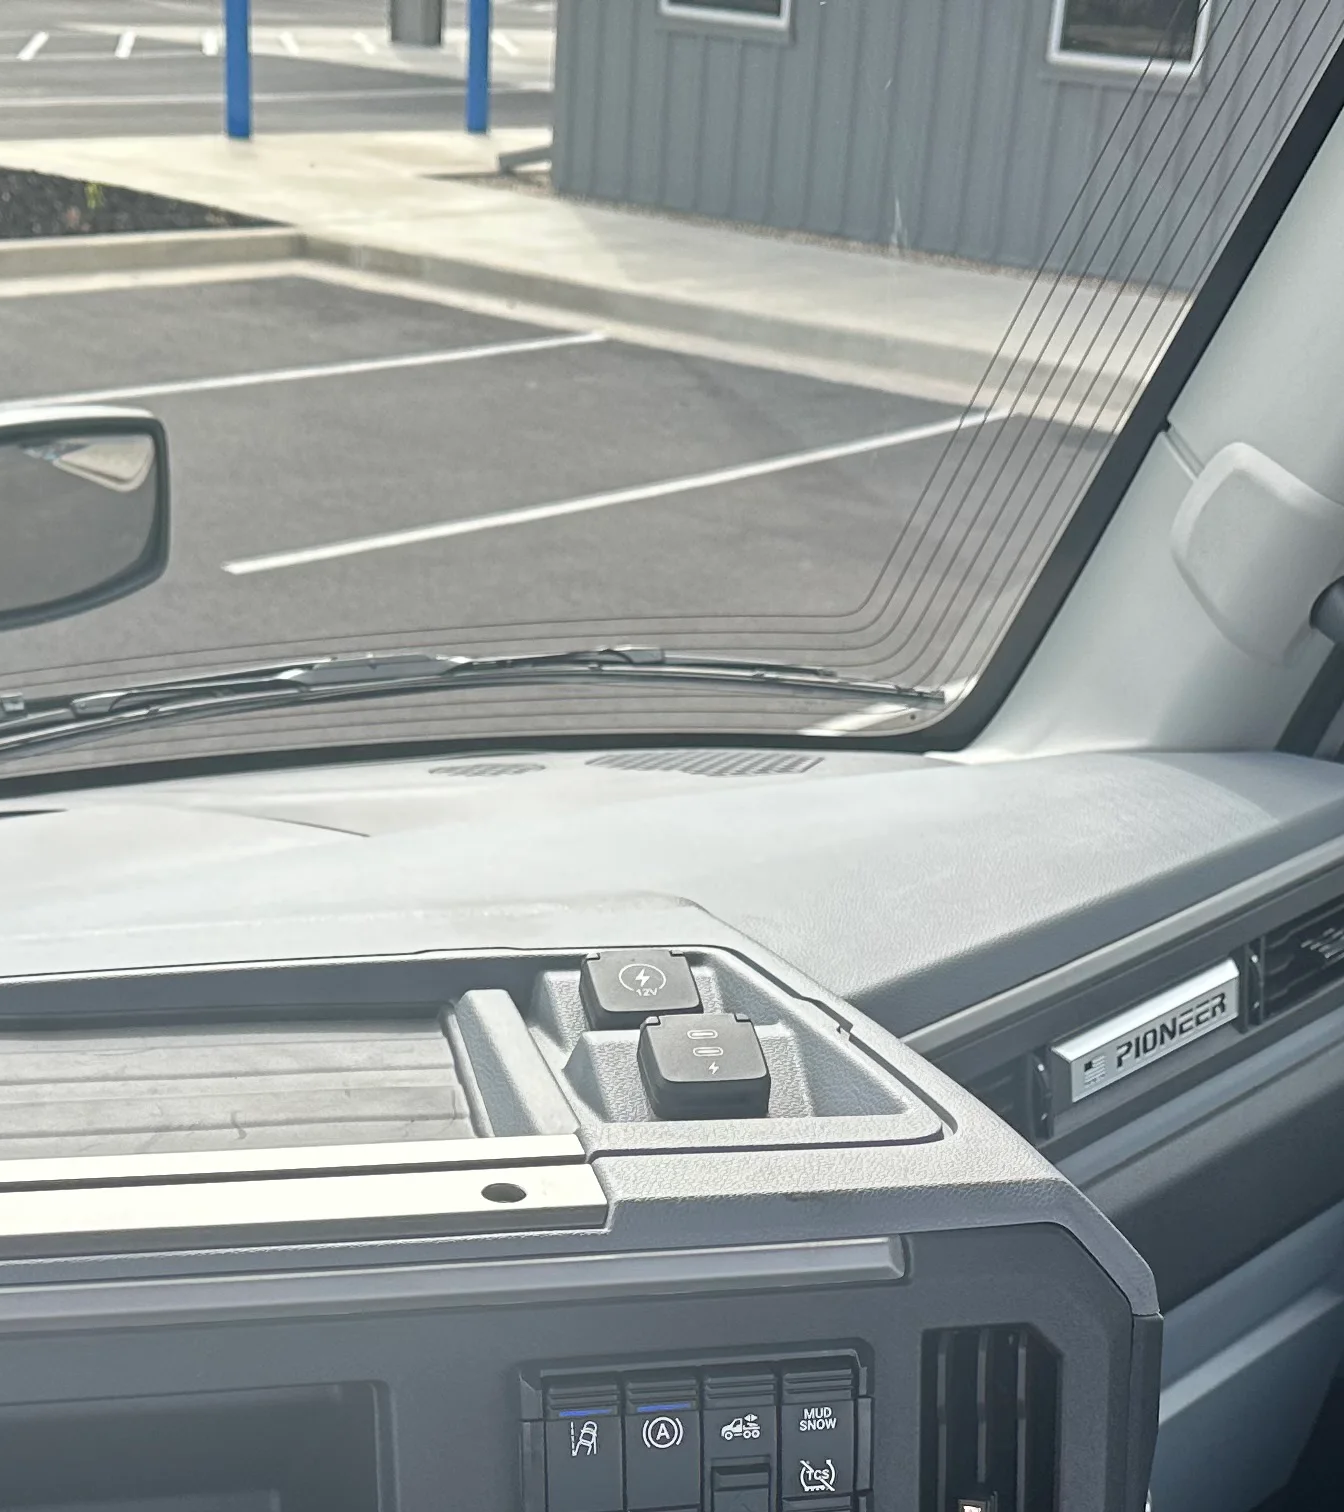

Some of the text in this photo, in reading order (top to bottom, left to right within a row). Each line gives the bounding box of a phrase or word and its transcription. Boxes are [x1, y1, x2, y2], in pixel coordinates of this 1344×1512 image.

[636, 988, 658, 996] 12V
[1116, 992, 1226, 1068] PIONEER
[804, 1406, 832, 1420] MUD
[799, 1418, 837, 1432] SNOW
[806, 1468, 830, 1480] TCS
